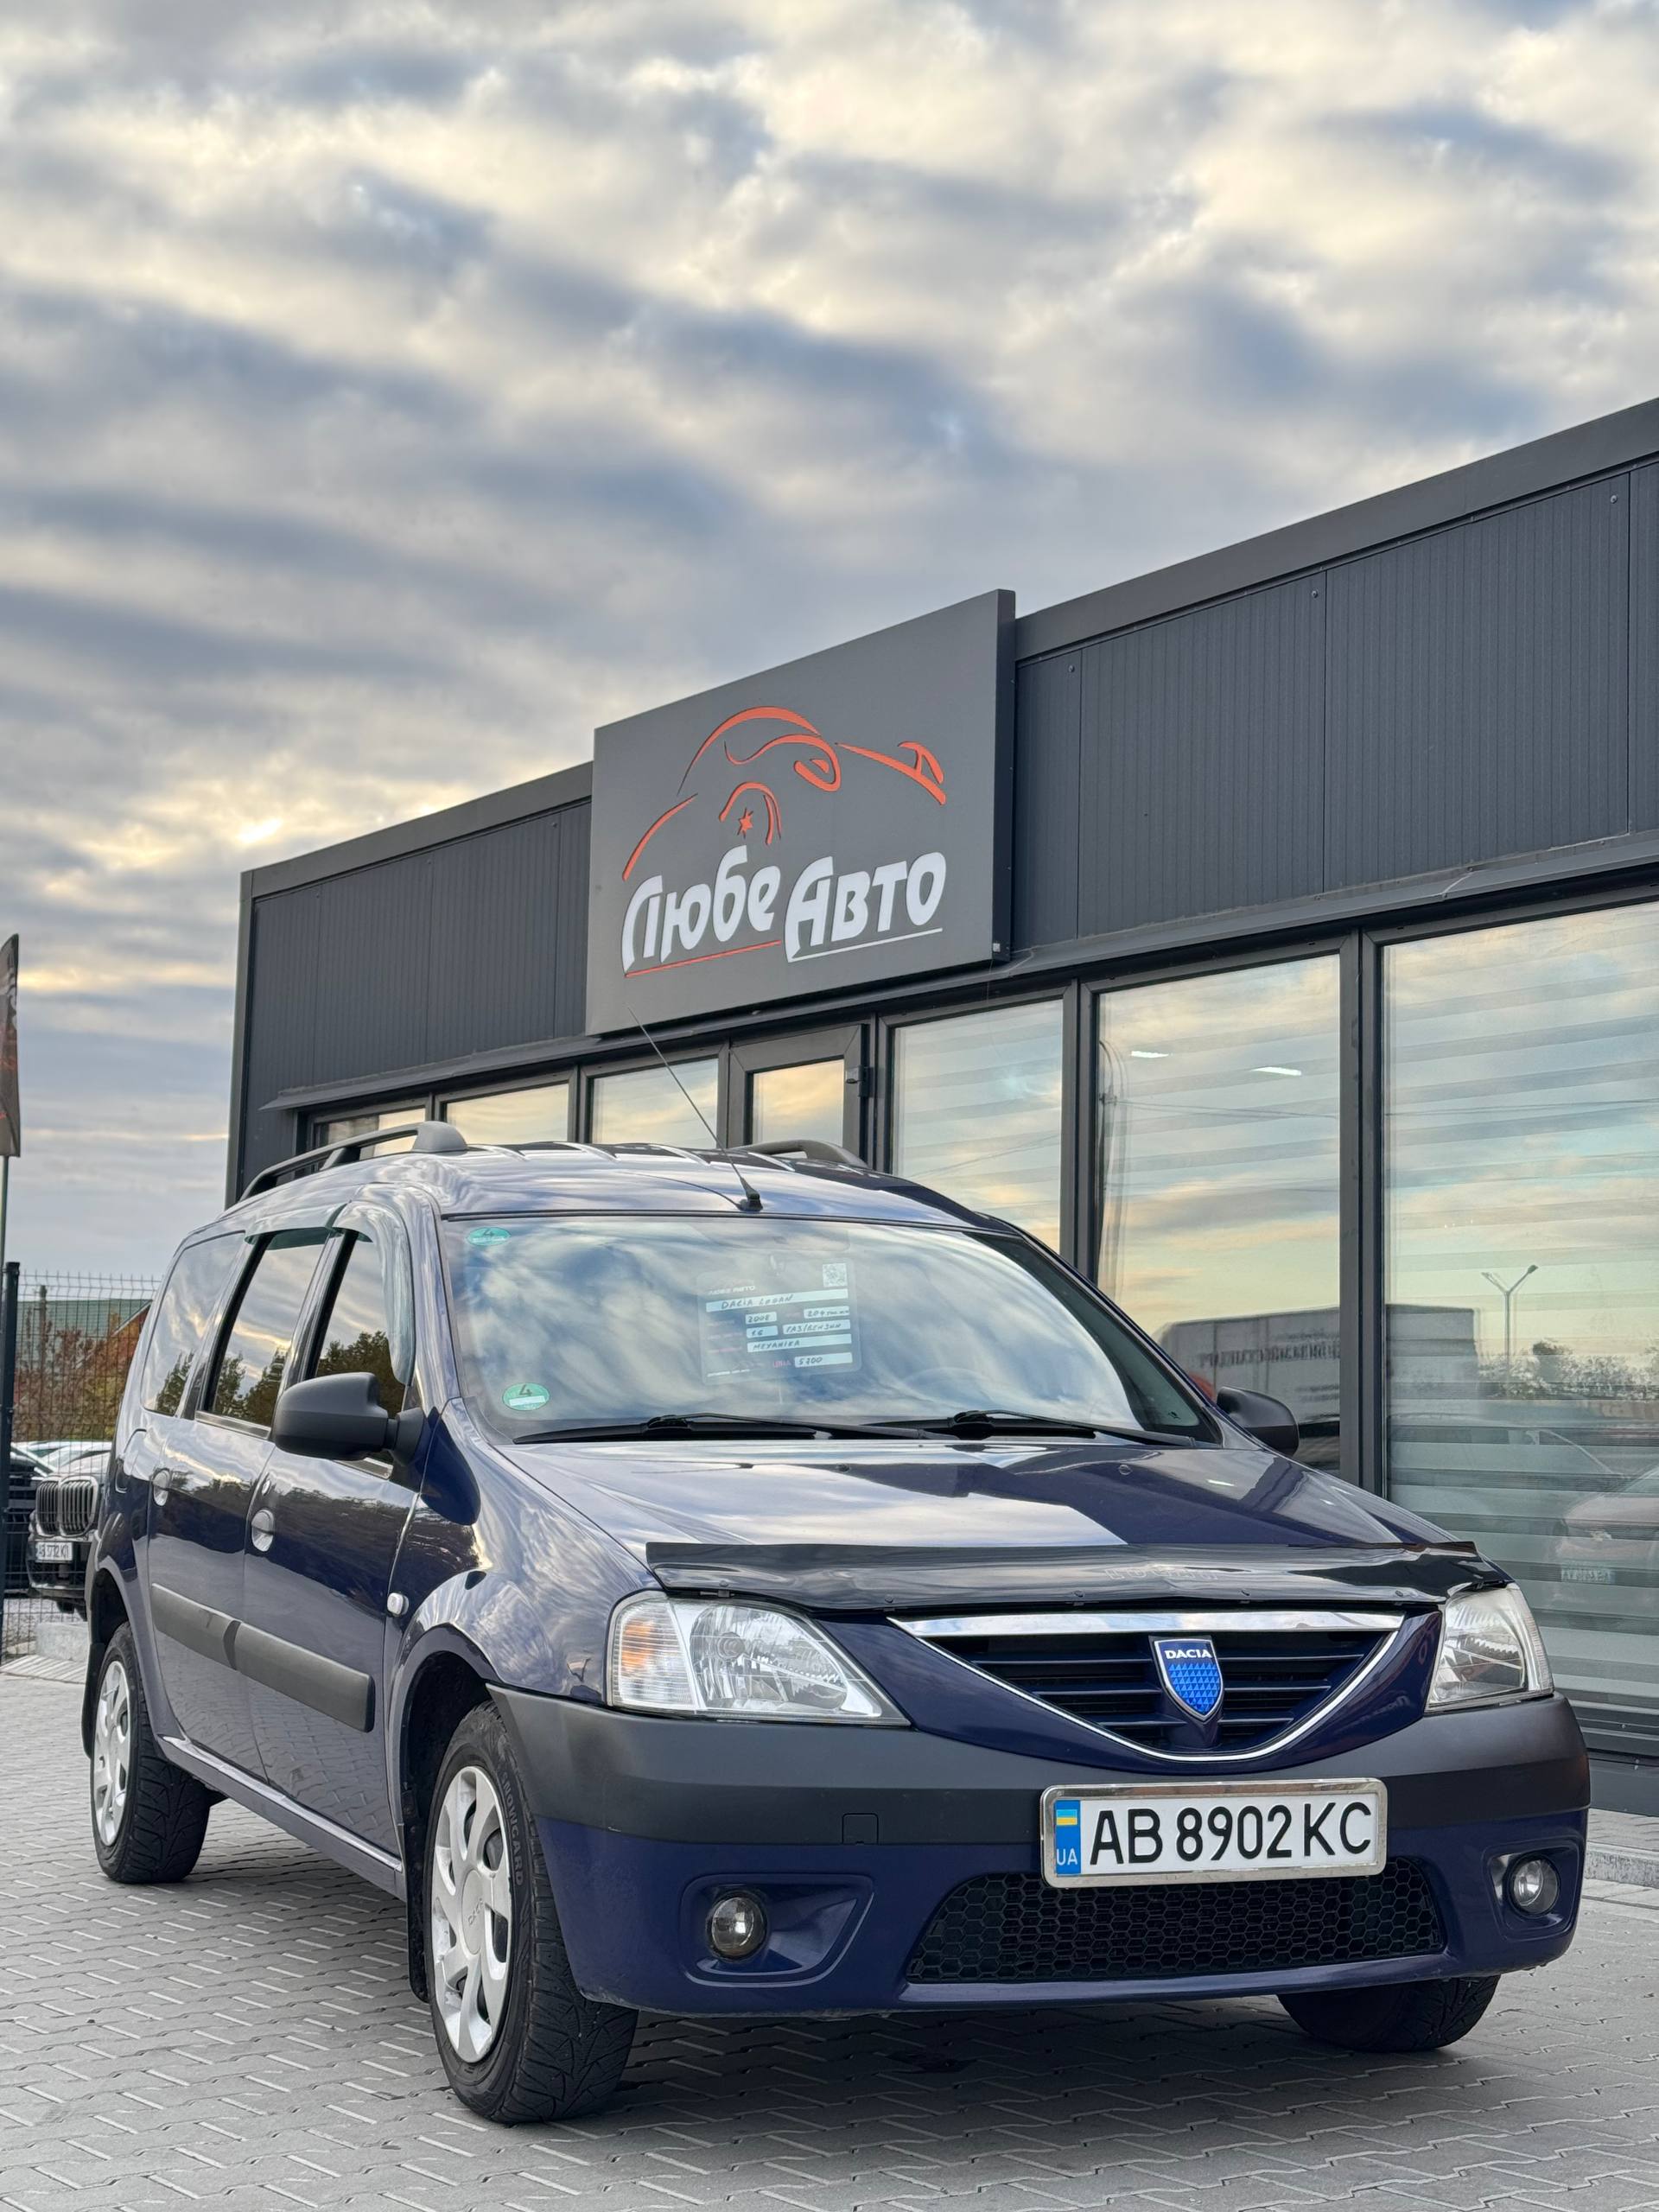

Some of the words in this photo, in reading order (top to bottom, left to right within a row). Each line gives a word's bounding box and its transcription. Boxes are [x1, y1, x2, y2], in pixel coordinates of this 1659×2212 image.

[785, 851, 947, 963] Авто
[518, 1383, 533, 1396] 4
[1164, 1649, 1213, 1660] DACIA
[1056, 1847, 1078, 1866] UA
